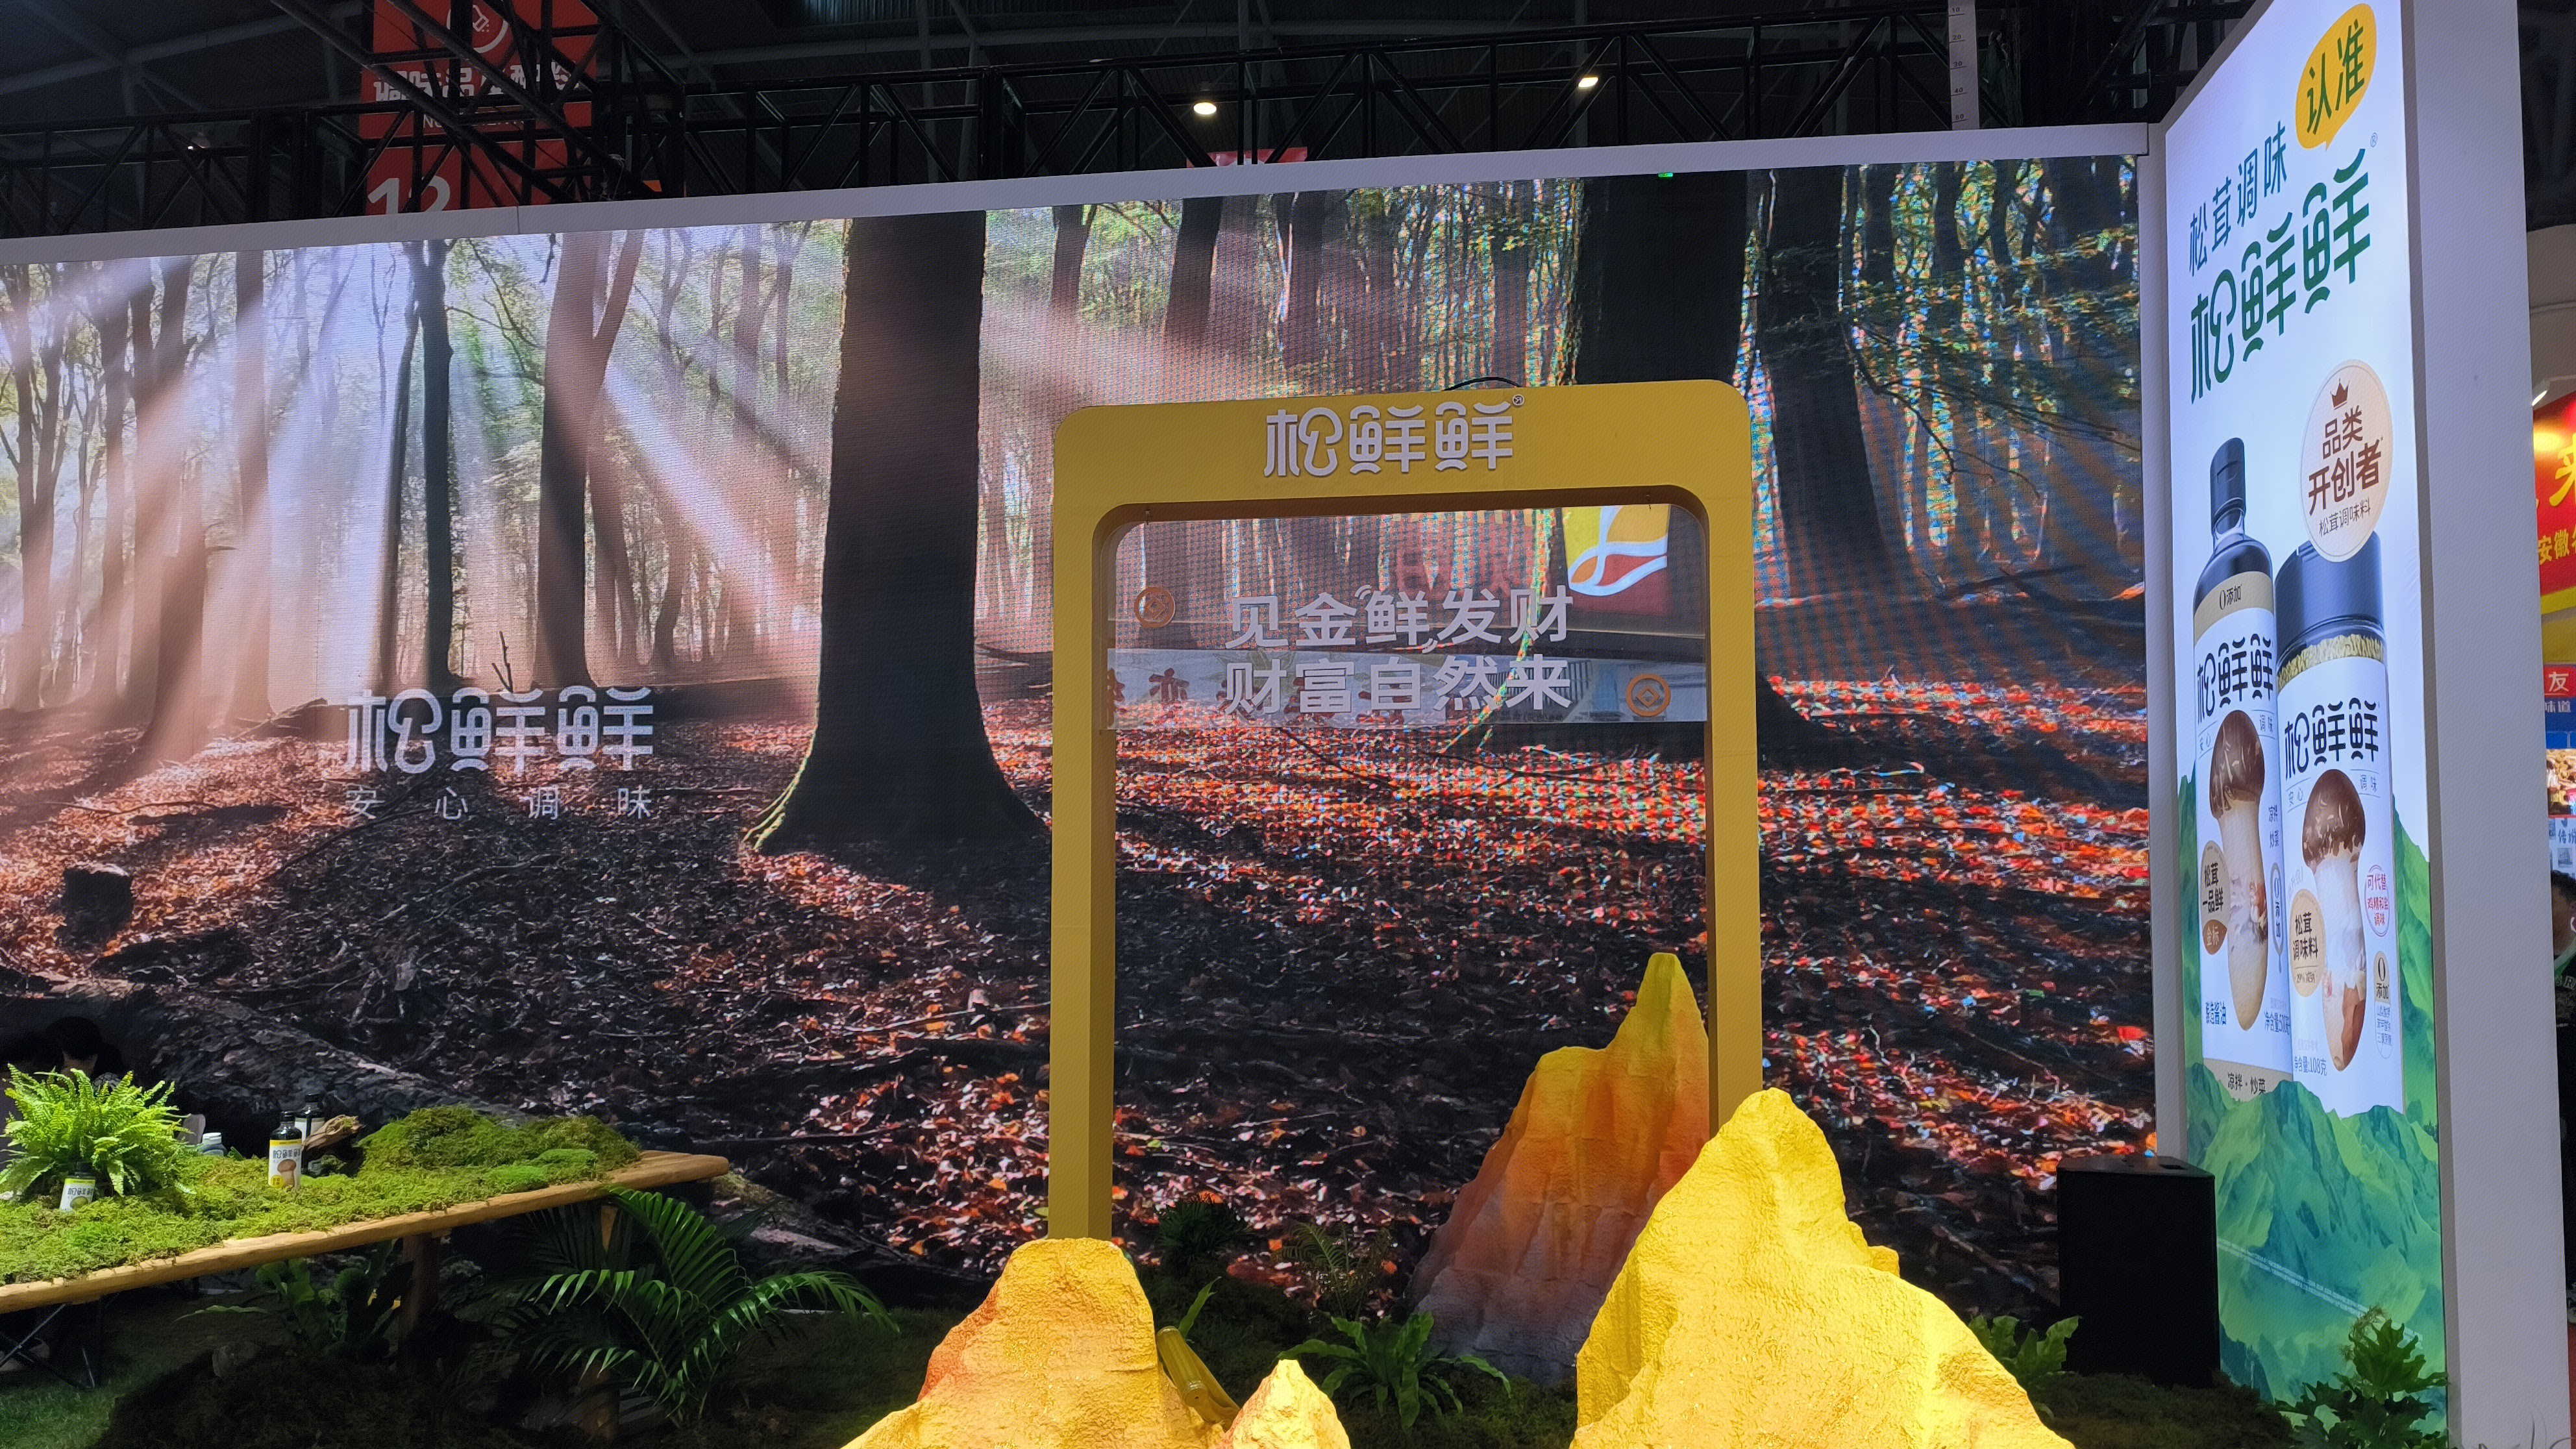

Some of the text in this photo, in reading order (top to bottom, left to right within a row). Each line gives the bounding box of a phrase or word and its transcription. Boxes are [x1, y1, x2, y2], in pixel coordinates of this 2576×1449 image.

[2307, 19, 2364, 135] 认准
[2189, 121, 2287, 277] 松茸调味
[2190, 148, 2371, 404] 松鲜鲜
[1263, 401, 1513, 477] 松鲜鲜
[2322, 406, 2363, 460] 品类
[2309, 438, 2381, 516] 开创者
[2319, 497, 2371, 537] 松茸调味料
[1225, 585, 1573, 649] 见金鲜发财
[1225, 654, 1572, 715] 财富自然来
[2197, 633, 2274, 724] 松鲜鲜
[343, 686, 654, 774] 松鲜鲜
[2285, 698, 2379, 781] 松鲜鲜
[345, 786, 651, 821] 安心调味
[2202, 887, 2224, 914] 一品鲜
[2204, 862, 2219, 888] 松茸
[2366, 873, 2387, 891] 可代替
[2292, 935, 2319, 961] 调味料
[2295, 912, 2312, 937] 松茸
